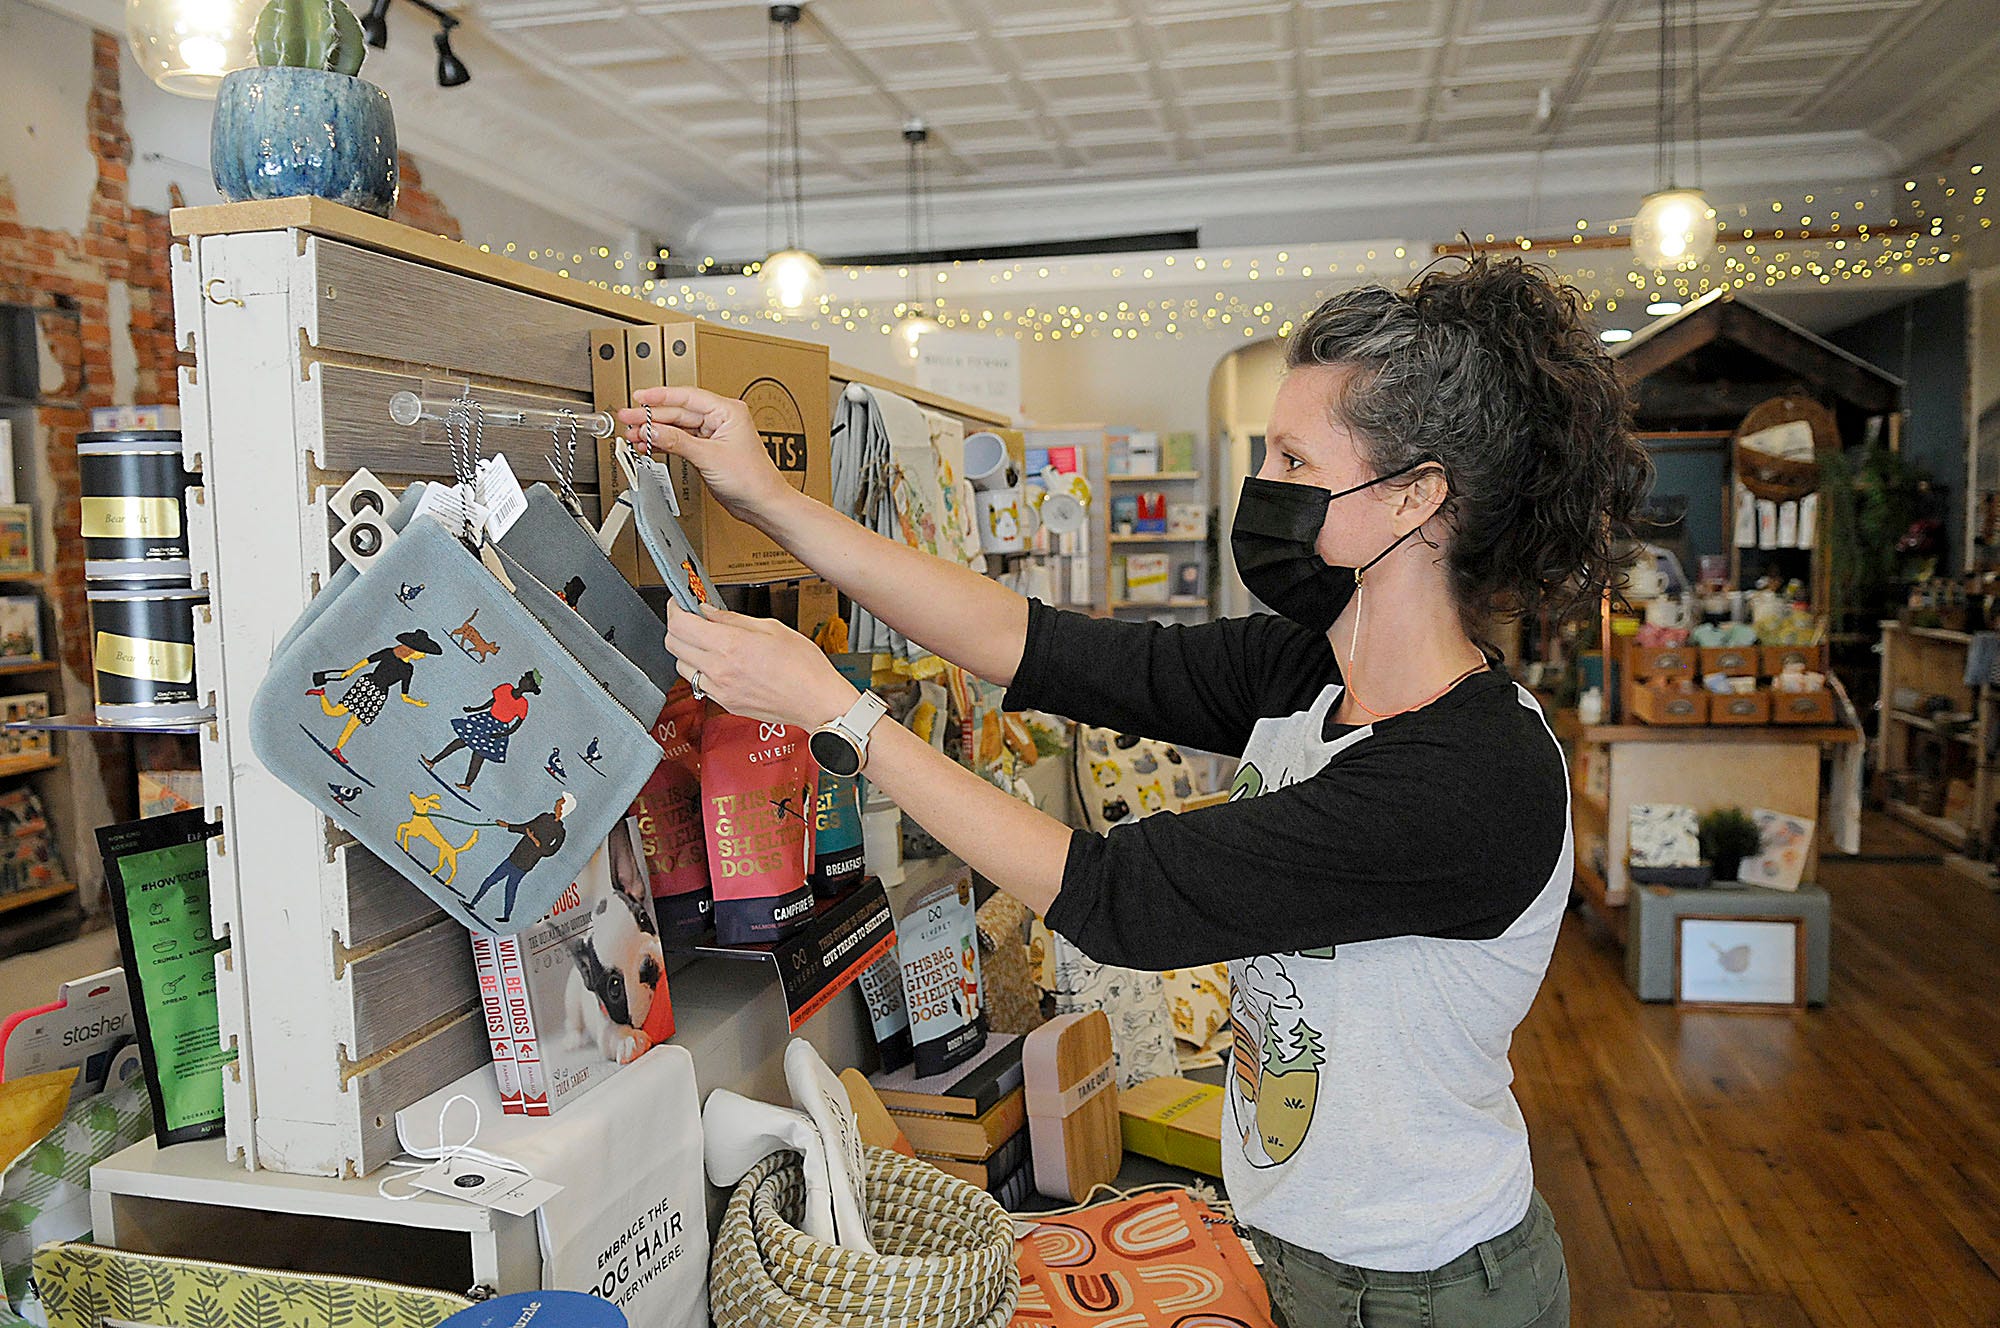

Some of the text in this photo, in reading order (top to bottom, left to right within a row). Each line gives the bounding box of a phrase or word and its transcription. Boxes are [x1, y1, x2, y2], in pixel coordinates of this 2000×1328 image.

[749, 743, 795, 763] GIVEPET
[712, 787, 767, 816] THIS
[720, 852, 784, 878] DOGS
[826, 856, 863, 876] BREAKFAST
[149, 917, 170, 927] SNACK
[773, 897, 809, 921] CAMPFIRE
[153, 953, 183, 966] CRUMBLE
[822, 948, 839, 968] GIVE
[837, 932, 859, 957] TREATS
[857, 926, 866, 940] TO
[903, 954, 933, 977] THIS
[932, 946, 954, 965] BAG
[473, 938, 506, 1034] WILL BE DOGS
[499, 939, 531, 1036] WILL BE DOGS
[906, 970, 943, 993] GIVES
[944, 961, 959, 977] TO
[909, 976, 961, 1009] SHELTER
[162, 995, 188, 1006] SPREAD
[912, 1000, 949, 1025] DOGS
[62, 1012, 128, 1047] stasher
[1078, 1066, 1110, 1100] TAKE OUT
[597, 1197, 669, 1270] EMBRACE THE
[635, 1211, 683, 1268] HAIR
